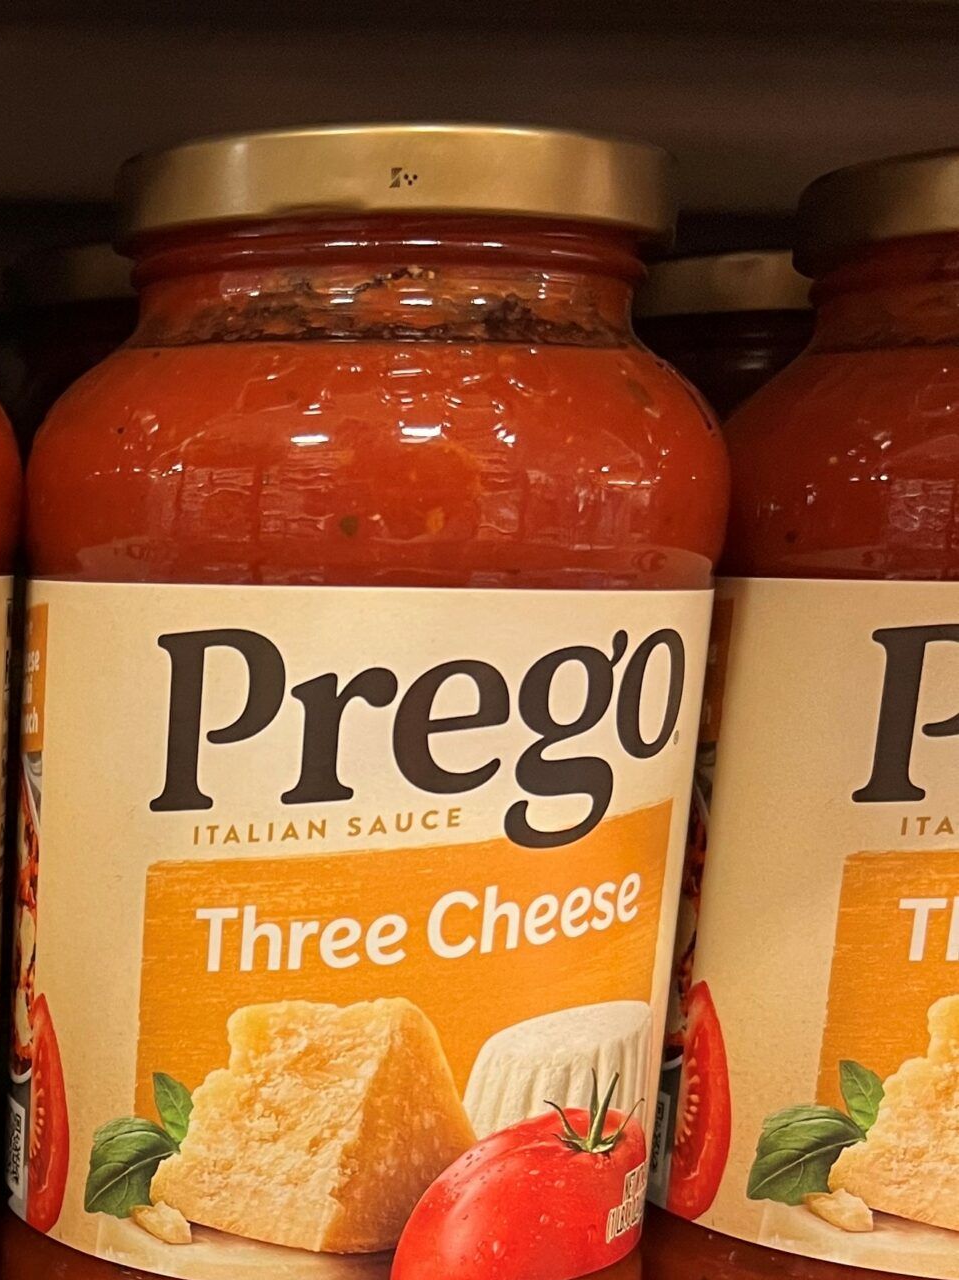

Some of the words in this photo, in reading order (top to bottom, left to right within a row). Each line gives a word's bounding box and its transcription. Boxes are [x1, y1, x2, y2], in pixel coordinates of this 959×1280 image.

[148, 627, 685, 849] Prego
[192, 818, 327, 847] ITALIAN
[347, 808, 463, 838] SAUCE
[196, 904, 406, 972] Three
[426, 872, 641, 960] Cheese
